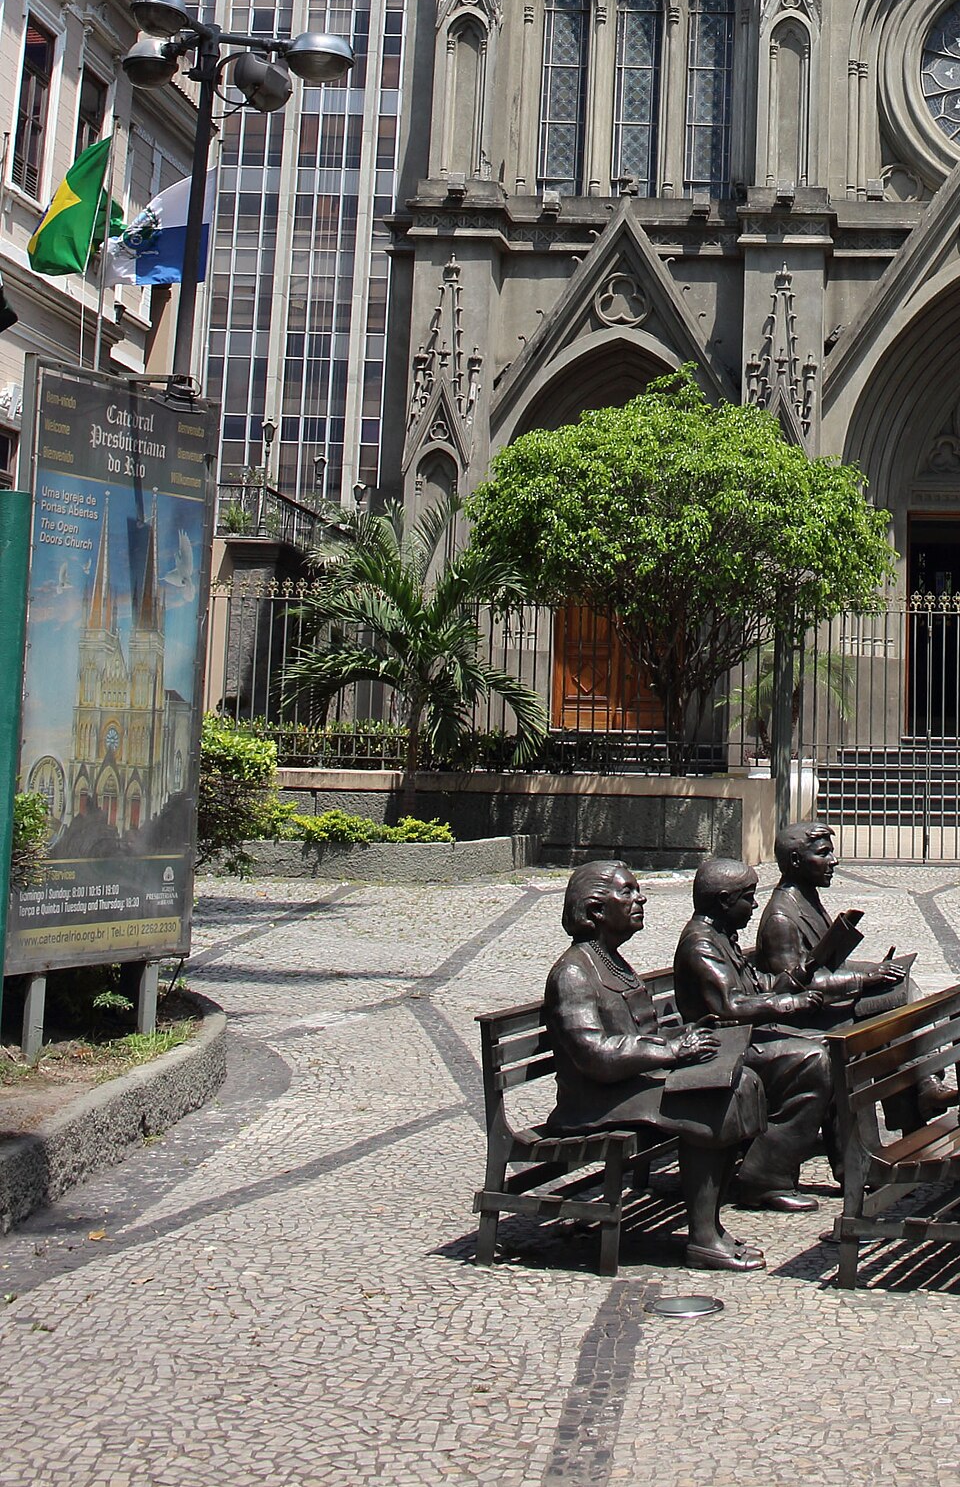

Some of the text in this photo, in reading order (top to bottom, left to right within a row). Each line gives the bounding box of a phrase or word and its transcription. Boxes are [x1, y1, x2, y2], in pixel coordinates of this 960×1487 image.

[46, 391, 76, 409] Bem-vindo
[45, 418, 70, 435] Welcome
[106, 404, 154, 433] Catedral
[89, 424, 166, 459] Presbiteriana
[44, 446, 74, 464] Bienvenido
[107, 453, 146, 478] do Rio
[41, 485, 97, 505] Uma Igreja de
[41, 500, 98, 520] Portas Abertas
[41, 517, 78, 534] The Open
[40, 532, 93, 550] Doors Church
[48, 888, 71, 901] Sunday:
[72, 886, 85, 898] 8:00
[41, 903, 60, 915] Quinta
[64, 901, 87, 914] Tuesday
[88, 899, 98, 911] and
[127, 923, 140, 937] (21)
